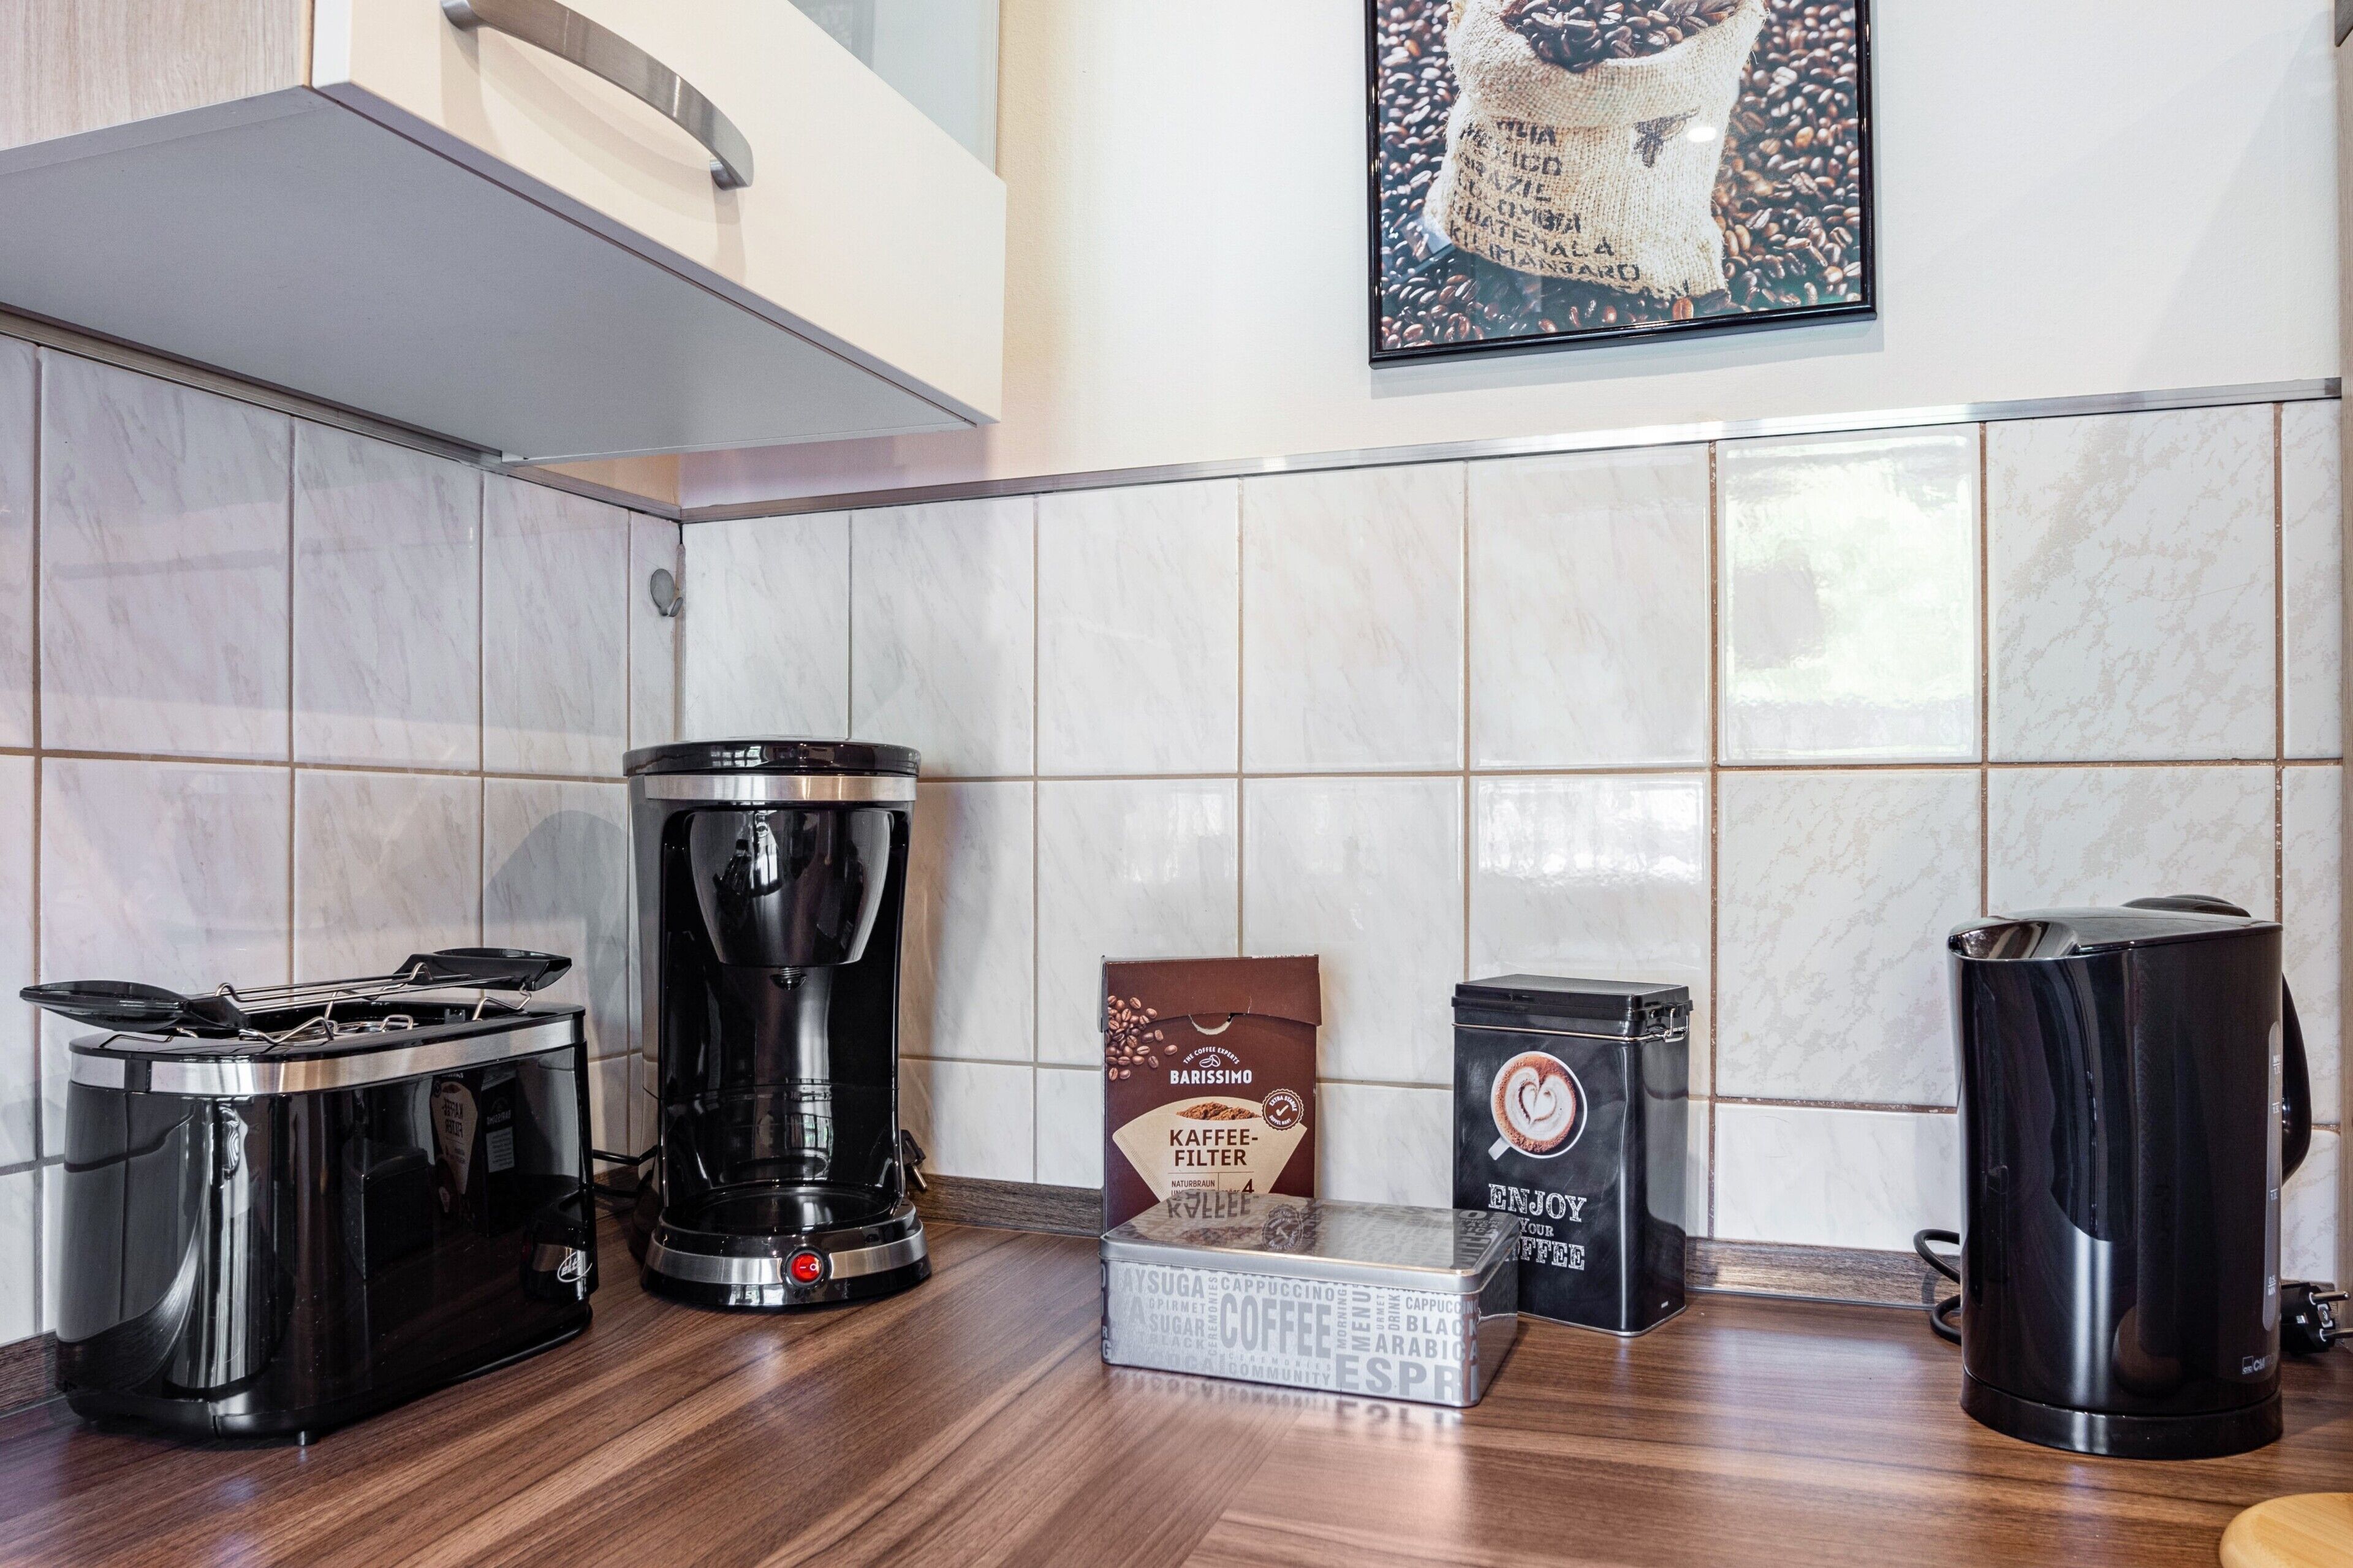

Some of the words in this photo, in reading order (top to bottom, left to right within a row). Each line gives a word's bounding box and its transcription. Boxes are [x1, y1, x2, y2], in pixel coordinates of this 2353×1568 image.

[1183, 1053, 1194, 1064] THE
[1194, 1047, 1216, 1056] COFFEE
[1218, 1047, 1240, 1064] EXPERTS
[1170, 1070, 1252, 1084] BARISSIMO
[1269, 1095, 1284, 1107] EXTRA
[1284, 1096, 1298, 1112] STABILE
[1170, 1129, 1258, 1146] KAFFEE-
[1175, 1149, 1247, 1167] FILTER
[1241, 1178, 1254, 1194] 4
[1488, 1183, 1587, 1222] ENJOY
[1518, 1217, 1554, 1237] YOUR
[1148, 1271, 1205, 1298] SUGA
[1221, 1277, 1335, 1301] CAPPUCCINO
[1149, 1297, 1206, 1314] GPIRMET
[1208, 1276, 1218, 1357] CEREMONIES
[1376, 1295, 1385, 1330] URMET
[1388, 1294, 1400, 1331] DRINK
[1406, 1297, 1479, 1314] CAPPUCCINO
[1149, 1314, 1205, 1337] SUGAR
[1220, 1293, 1332, 1359] COFFEE
[1337, 1289, 1347, 1349] MORNING
[1352, 1290, 1371, 1352] MENU
[1407, 1315, 1477, 1337] BLACK
[1150, 1334, 1205, 1350] BLACK
[1375, 1333, 1477, 1362] ARABICA
[1229, 1352, 1331, 1372] CEREMONIES
[1229, 1362, 1330, 1386] COMMUNITY
[1336, 1354, 1478, 1403] ESPR
